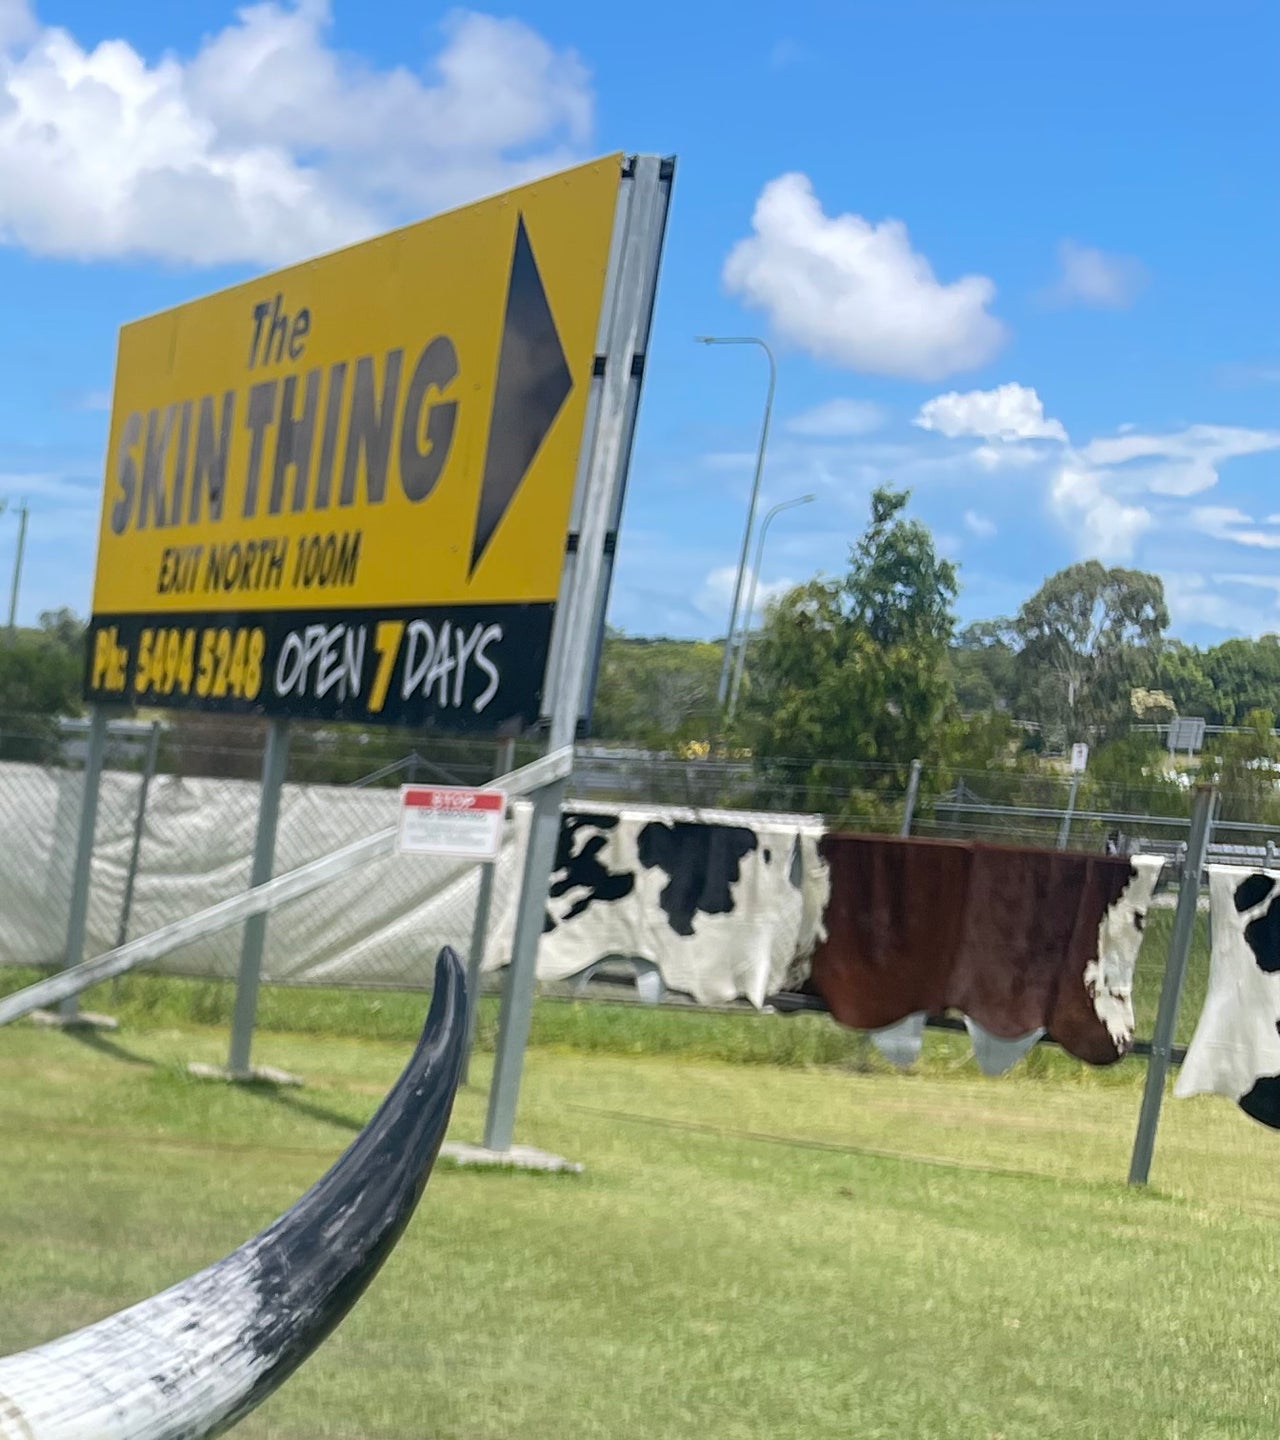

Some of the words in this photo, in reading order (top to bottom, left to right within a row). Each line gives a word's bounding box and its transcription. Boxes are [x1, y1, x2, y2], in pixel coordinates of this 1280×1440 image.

[249, 293, 309, 368] The
[111, 389, 236, 536] SKIN
[242, 336, 458, 517] THING
[158, 545, 203, 593] EXIT
[206, 538, 288, 591] NORTH
[294, 532, 361, 587] 100M
[134, 627, 196, 696] 5494
[197, 627, 265, 700] 5248
[275, 623, 366, 698] OPEN
[368, 620, 404, 712] 7
[402, 618, 503, 713] DAYS
